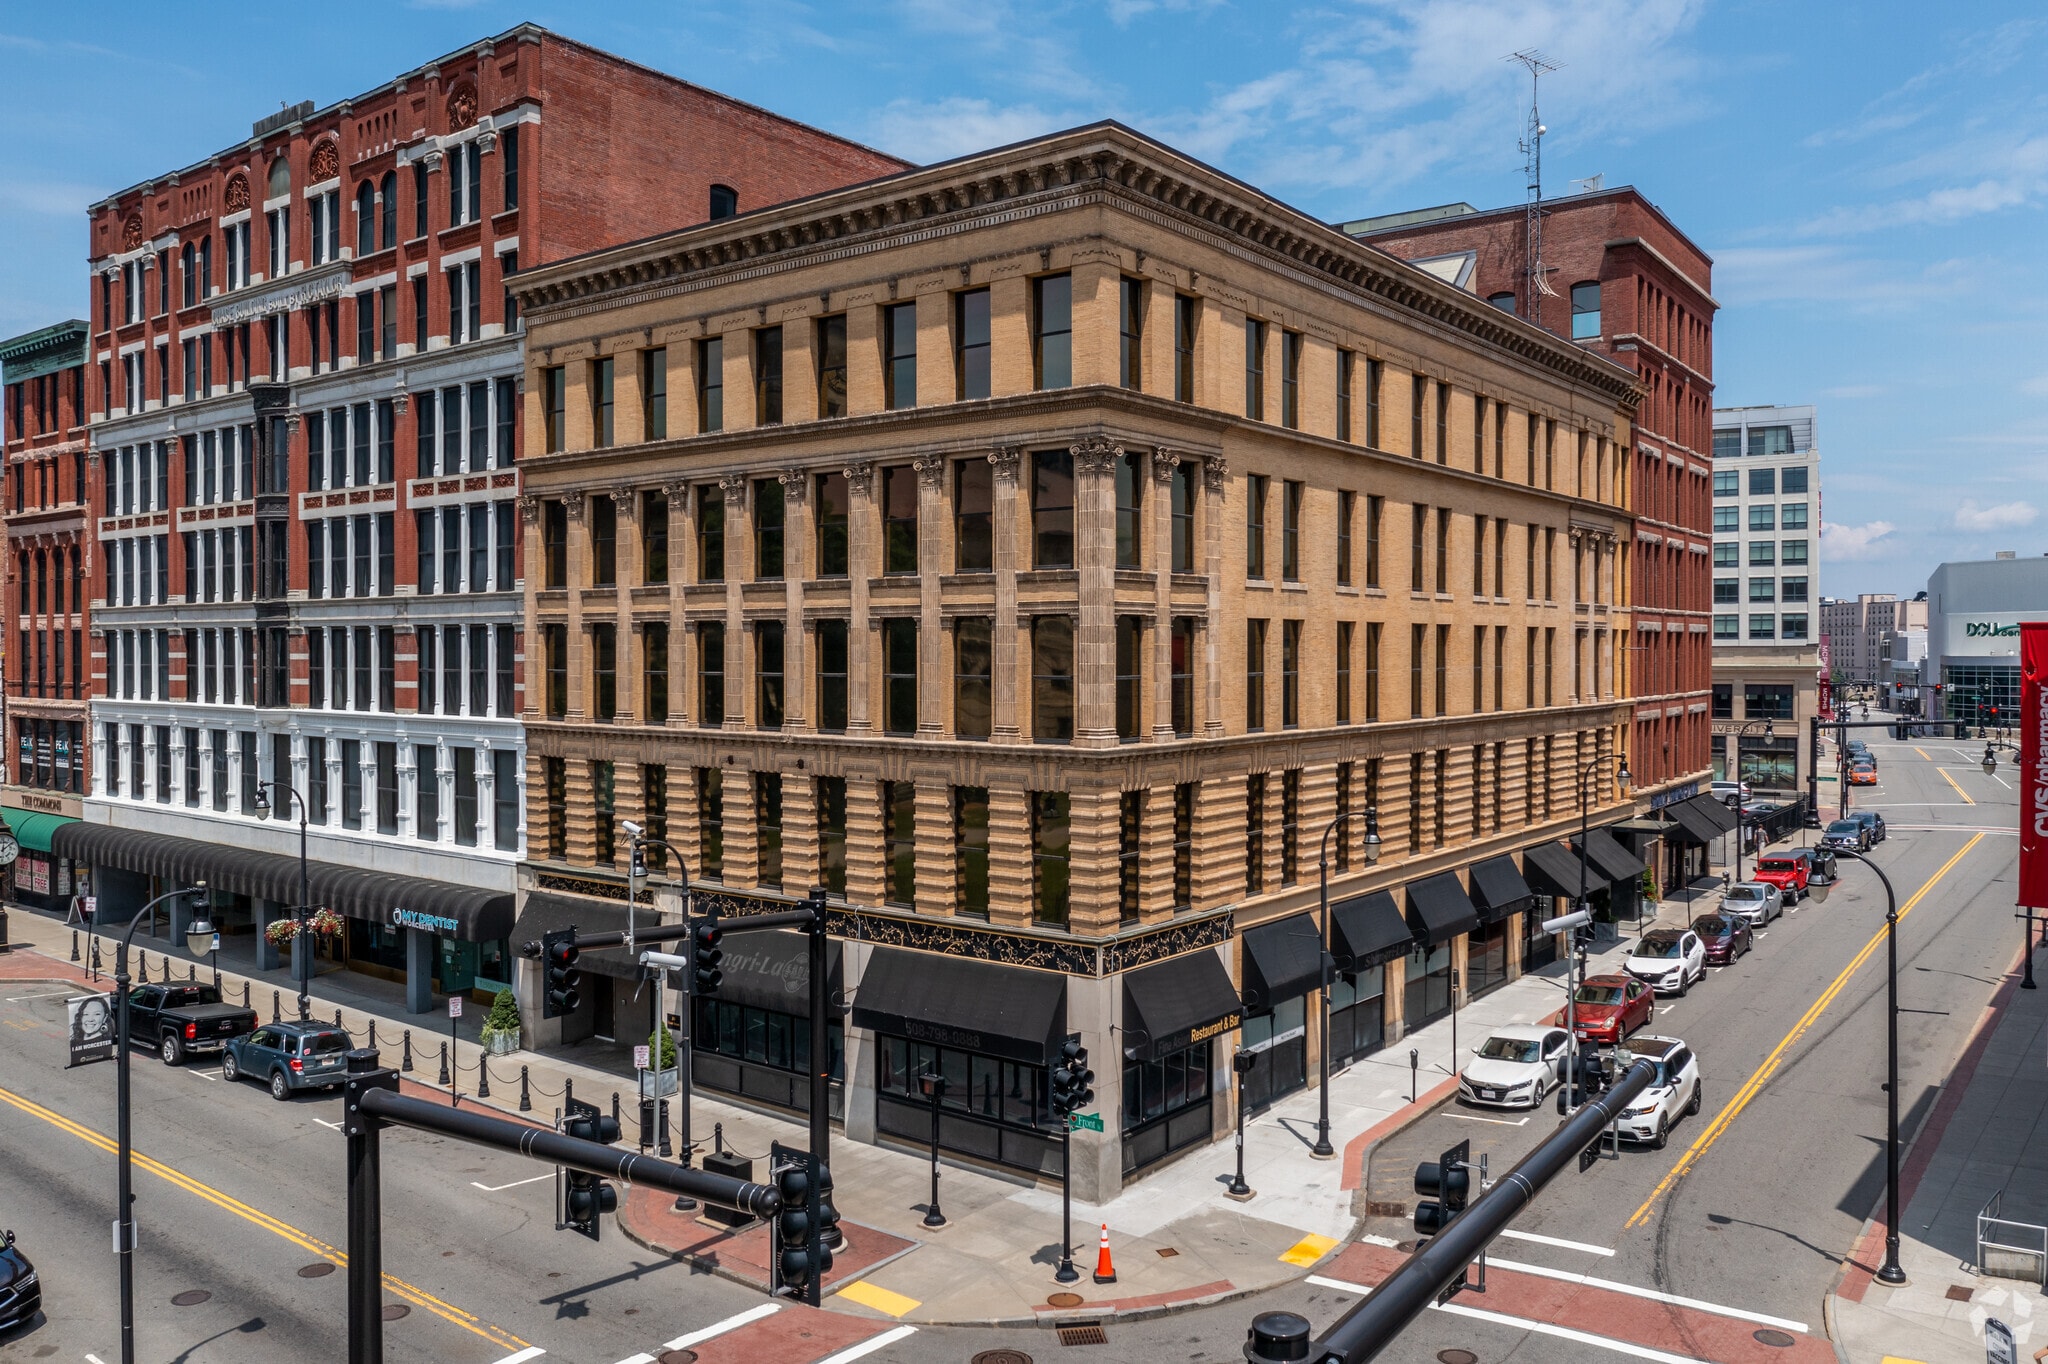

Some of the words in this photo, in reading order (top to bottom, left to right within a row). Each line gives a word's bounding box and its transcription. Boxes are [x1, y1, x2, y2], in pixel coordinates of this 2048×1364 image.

[1966, 622, 1999, 637] DCU
[1821, 645, 1829, 673] MCPHS
[1713, 724, 1768, 734] IVERSIT
[402, 909, 418, 921] MY
[419, 912, 459, 931] DENTIST
[720, 951, 785, 976] ngri-La
[1191, 1018, 1223, 1043] Restaurant
[1223, 1016, 1229, 1030] &
[1229, 1014, 1240, 1028] Bar
[83, 1039, 112, 1050] WORCESTER
[1078, 1115, 1096, 1129] Front
